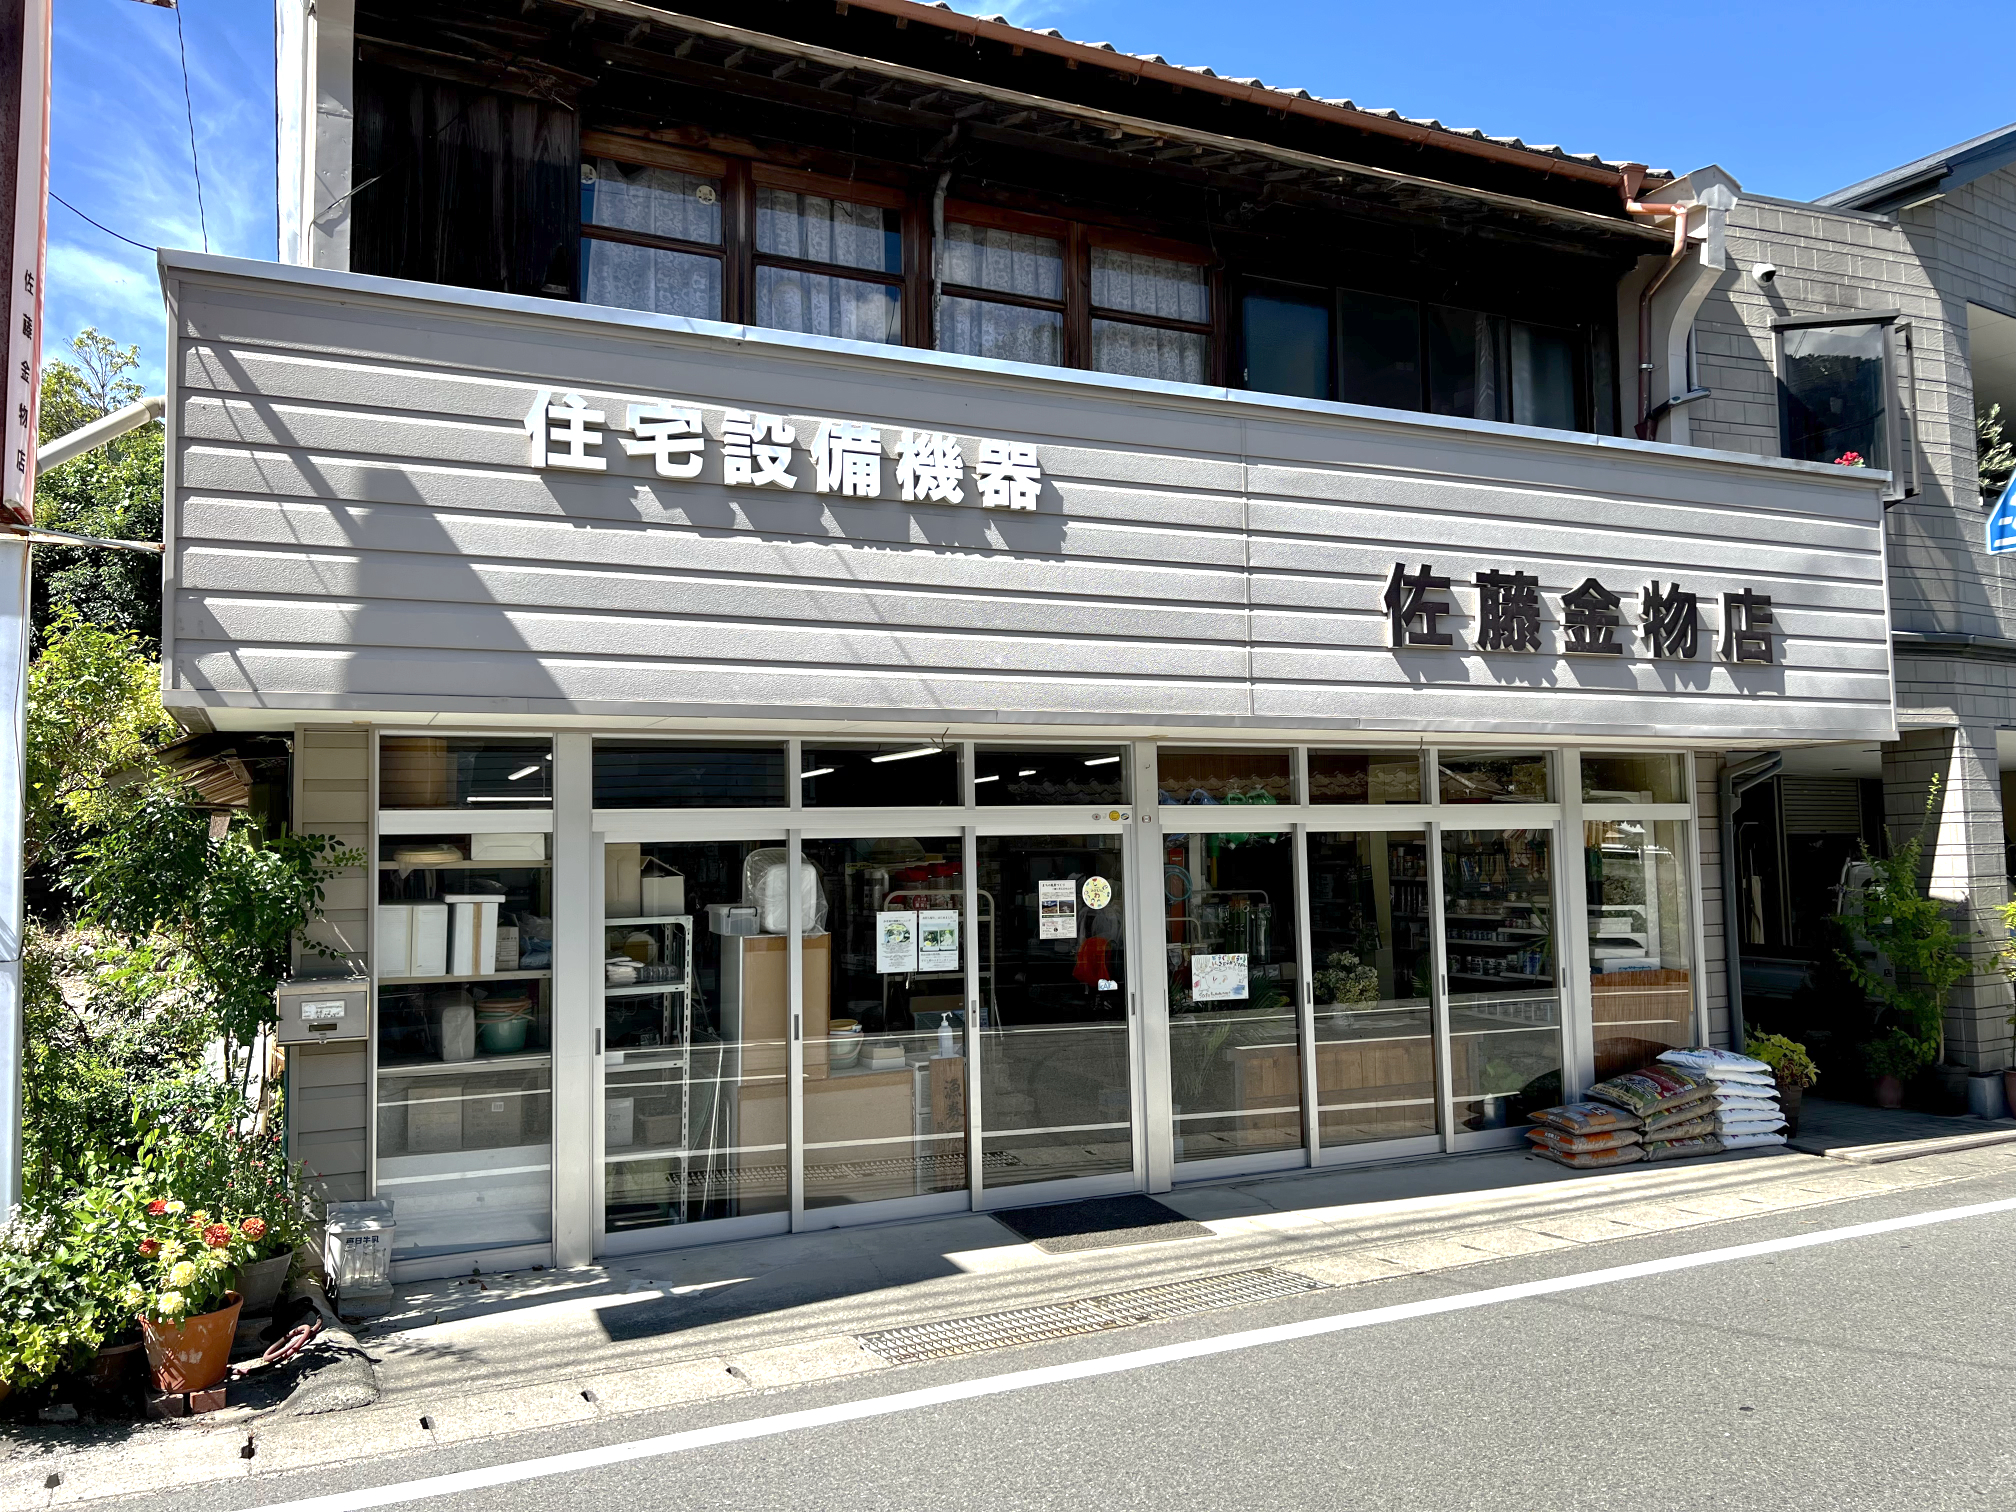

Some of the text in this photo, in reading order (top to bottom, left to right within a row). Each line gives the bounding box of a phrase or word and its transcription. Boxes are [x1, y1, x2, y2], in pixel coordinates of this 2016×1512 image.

[16, 269, 34, 475] 佐藤金物店
[523, 389, 1042, 511] 住宅設備機器
[1380, 562, 1774, 664] 佐藤金物店
